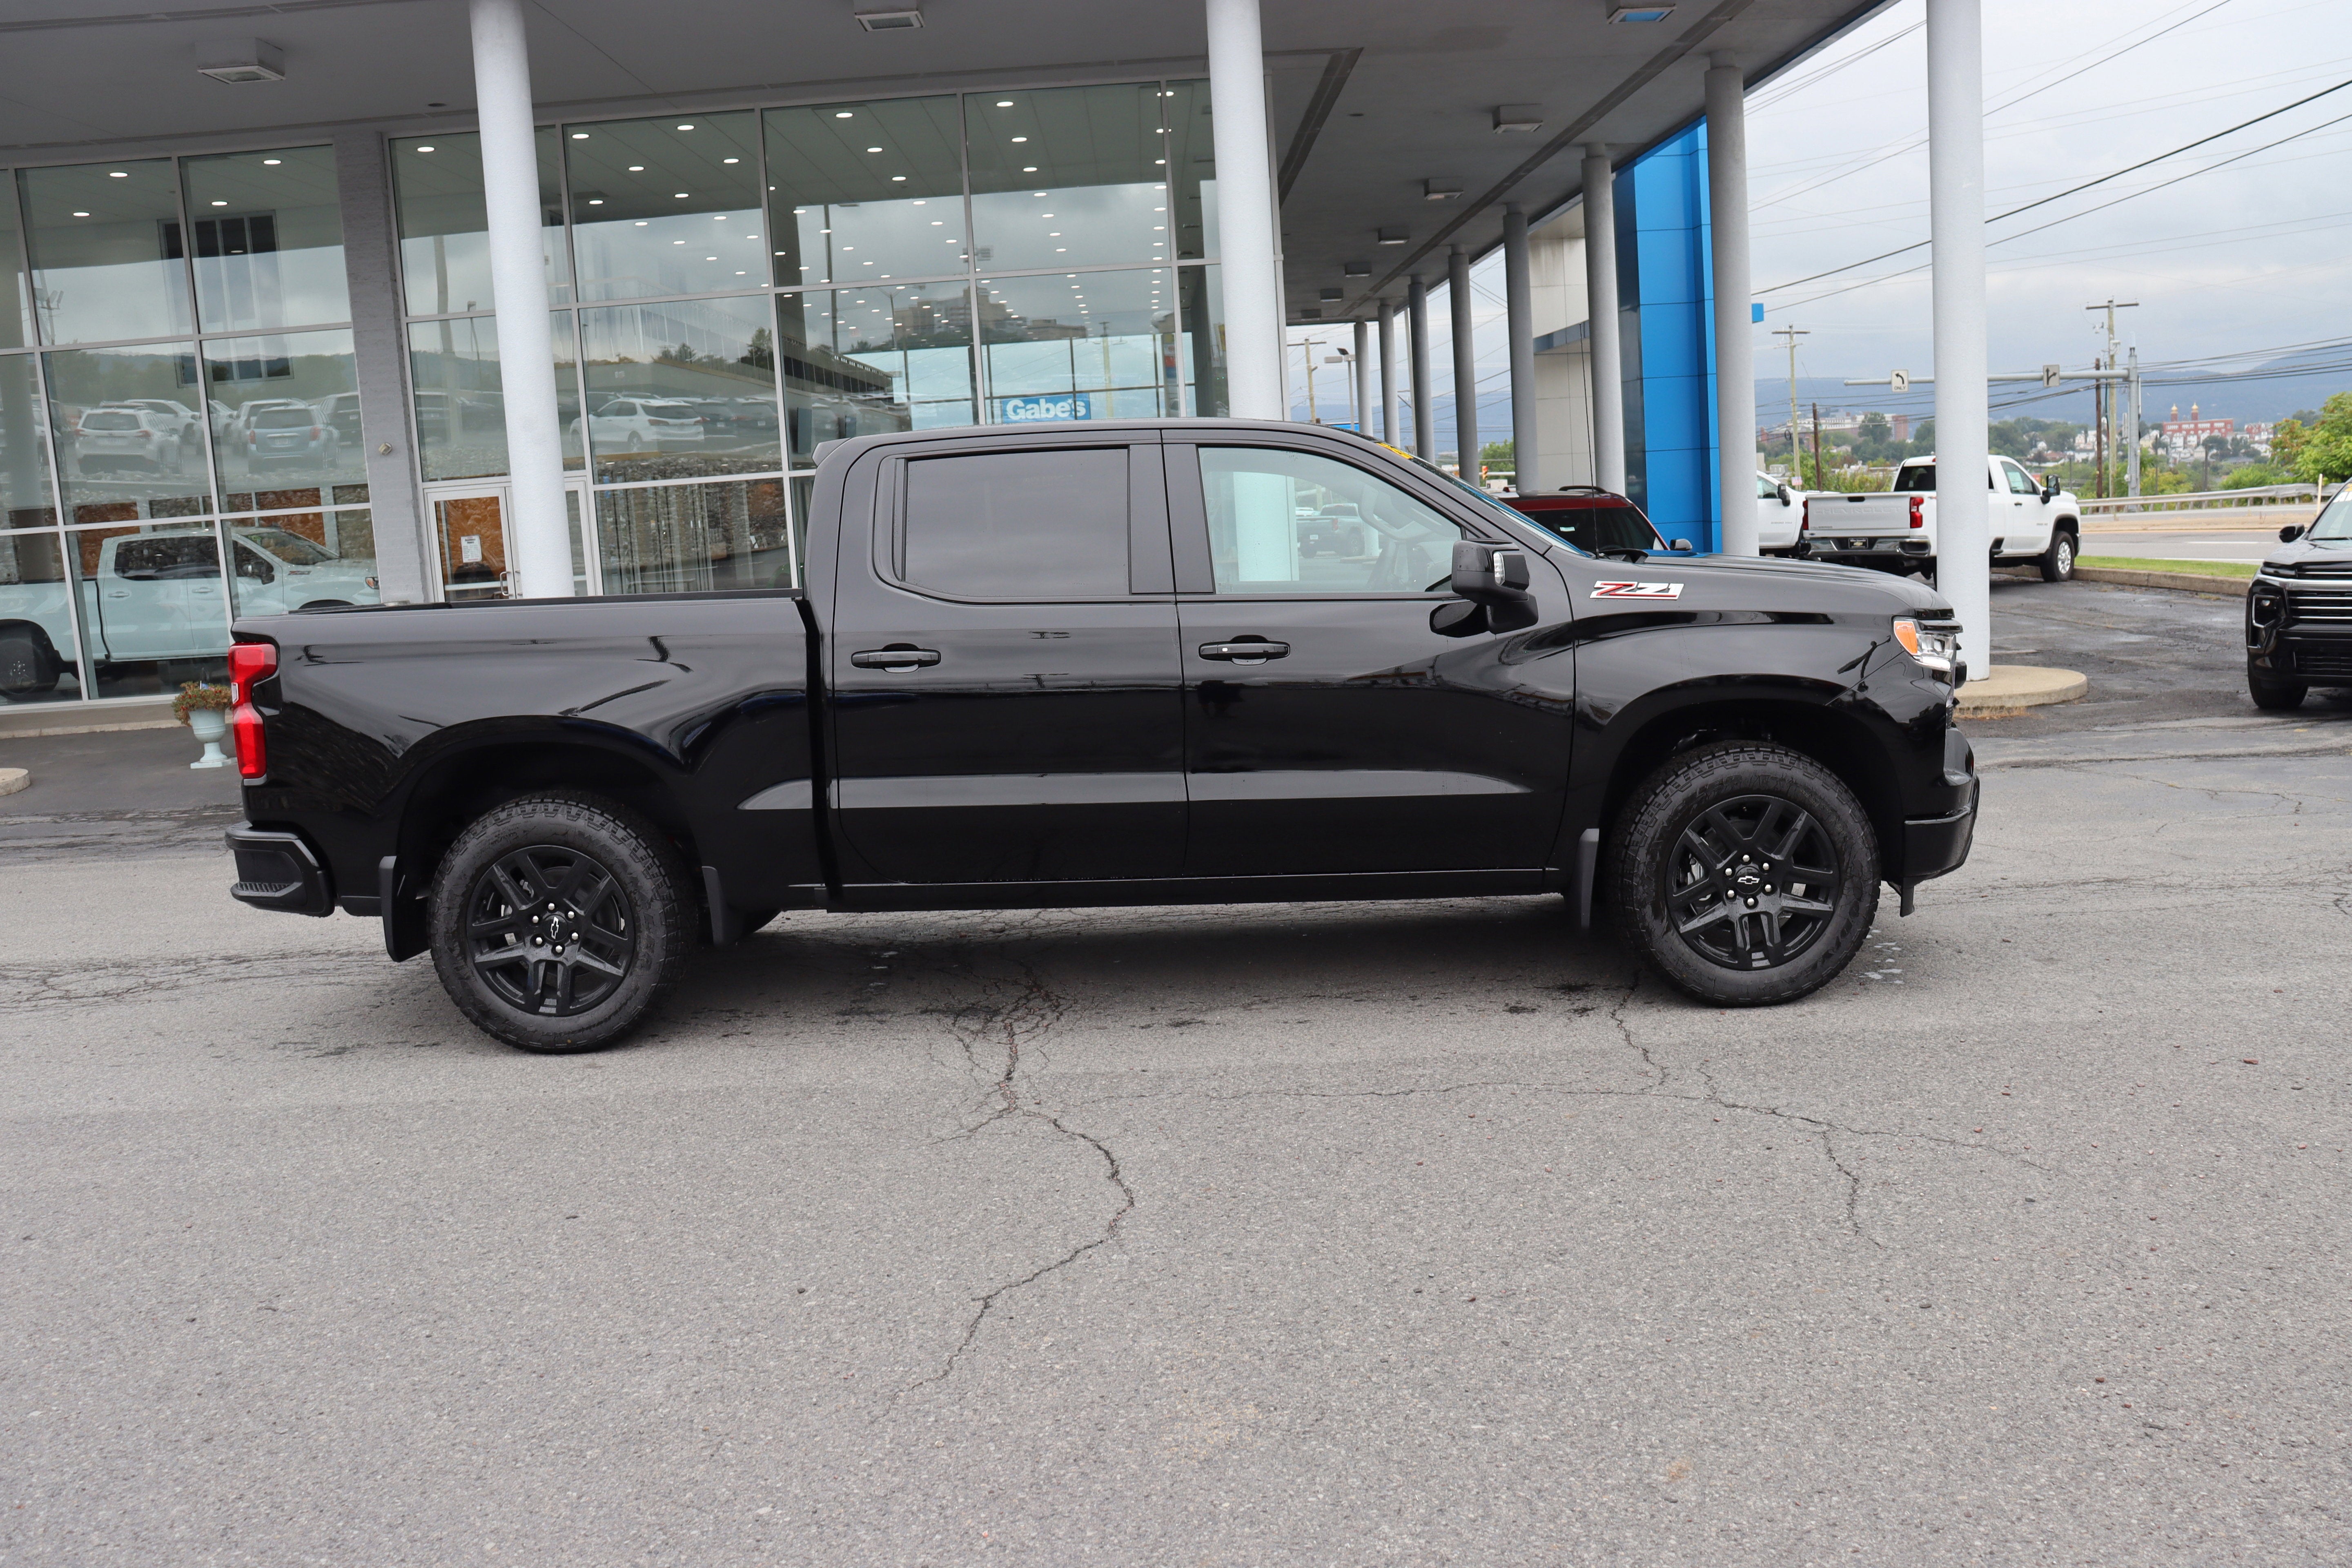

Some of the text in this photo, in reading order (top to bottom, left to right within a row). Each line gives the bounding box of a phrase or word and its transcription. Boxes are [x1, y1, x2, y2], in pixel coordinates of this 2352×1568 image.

[1006, 398, 1086, 420] Gabe's
[1814, 506, 1902, 515] CHEVROLET
[1590, 580, 1684, 600] Z71
